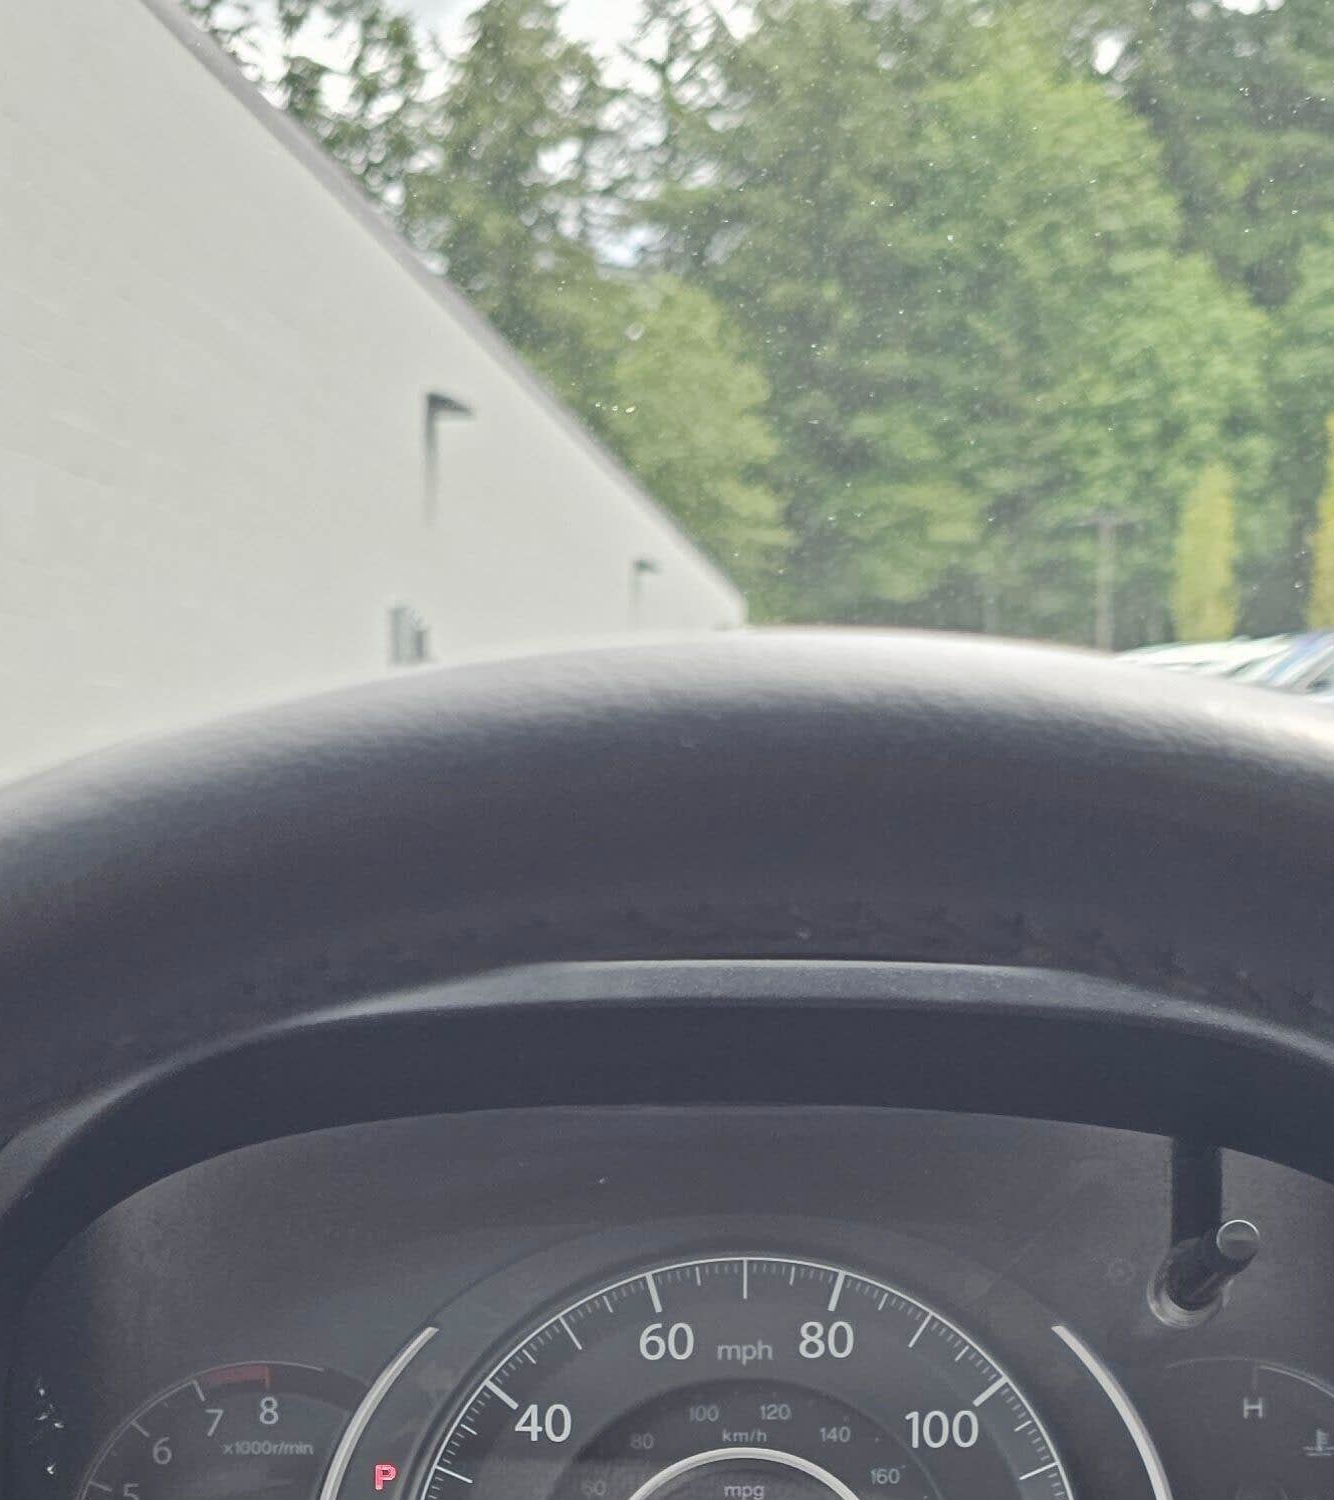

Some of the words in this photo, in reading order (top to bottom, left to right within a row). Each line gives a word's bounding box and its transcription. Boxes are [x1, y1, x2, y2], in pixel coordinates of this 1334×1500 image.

[639, 1323, 695, 1360] 60
[717, 1340, 774, 1366] mph
[798, 1321, 855, 1359] 80
[258, 1396, 279, 1425] 8
[689, 1405, 719, 1422] 100
[760, 1404, 791, 1421] 120
[1243, 1398, 1264, 1419] H
[205, 1409, 225, 1437] 7
[514, 1404, 572, 1442] 40
[722, 1428, 768, 1443] km/h
[820, 1426, 851, 1442] 140
[905, 1410, 979, 1449] 100
[152, 1437, 172, 1464] 6
[630, 1433, 654, 1449] 80
[374, 1463, 397, 1491] P
[870, 1468, 900, 1485] 160
[724, 1485, 765, 1500] mpg
